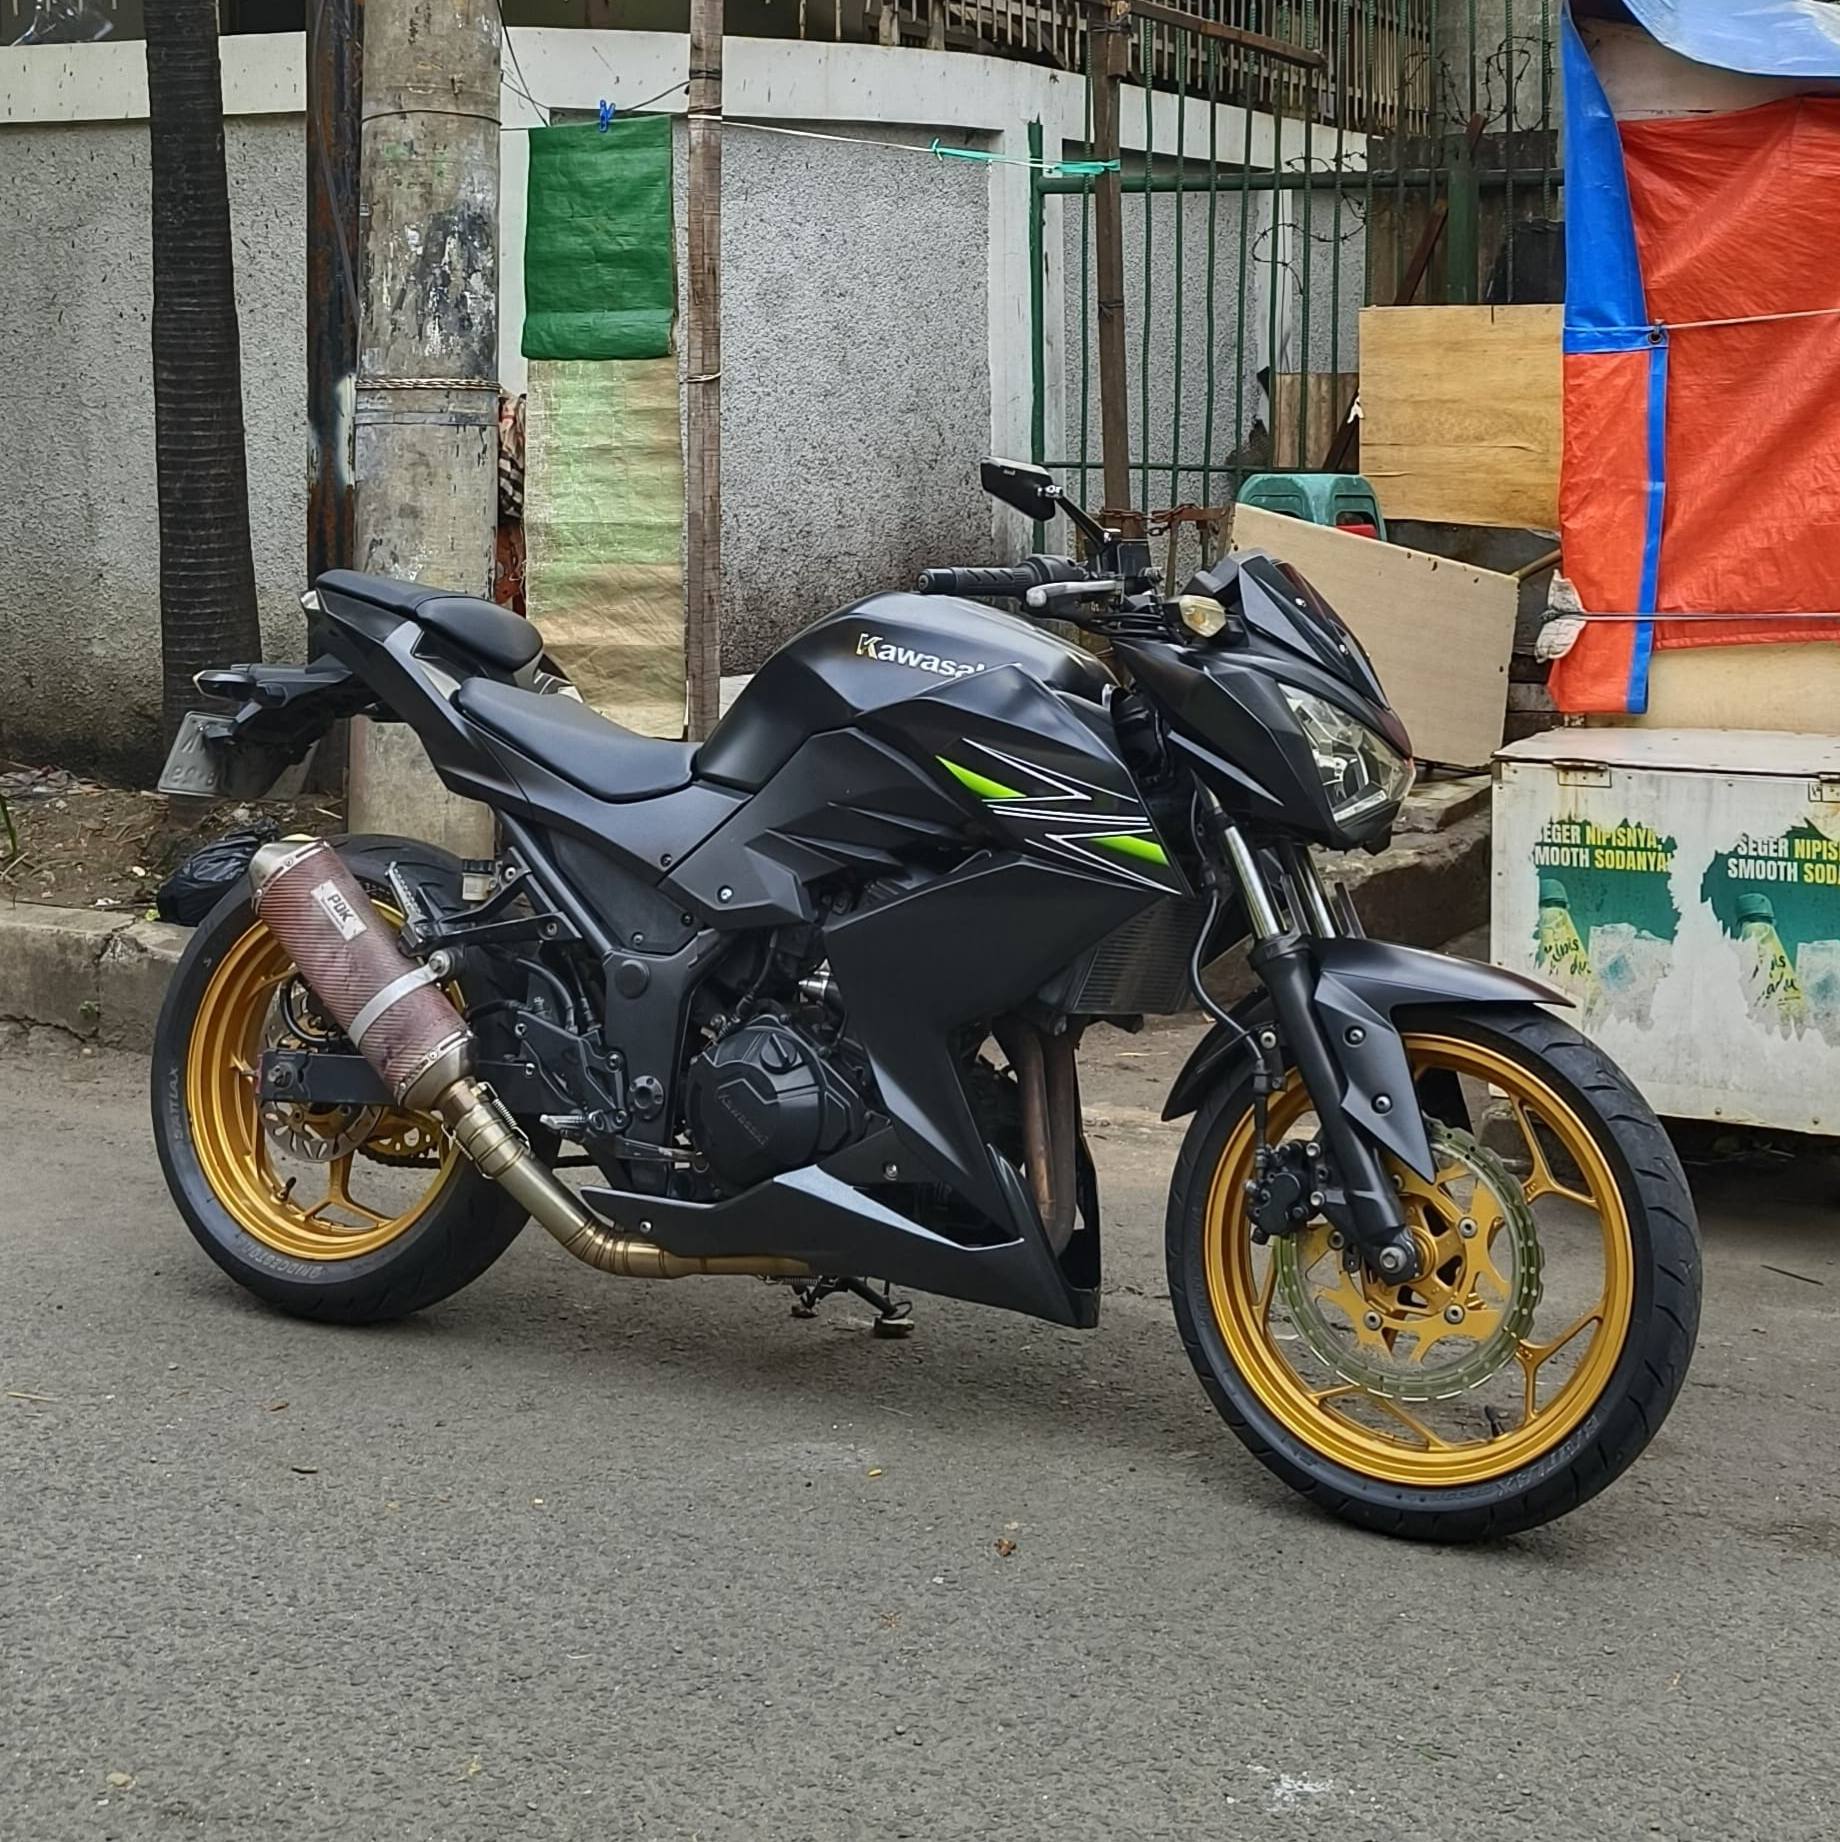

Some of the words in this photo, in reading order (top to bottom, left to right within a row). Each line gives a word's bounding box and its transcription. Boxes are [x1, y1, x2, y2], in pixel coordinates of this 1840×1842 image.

[856, 633, 986, 678] Kawasa
[1737, 837, 1789, 858] SEGER
[1794, 838, 1840, 861] NIPIS
[1727, 858, 1798, 882] SMOOTH
[1803, 863, 1840, 885] SOD
